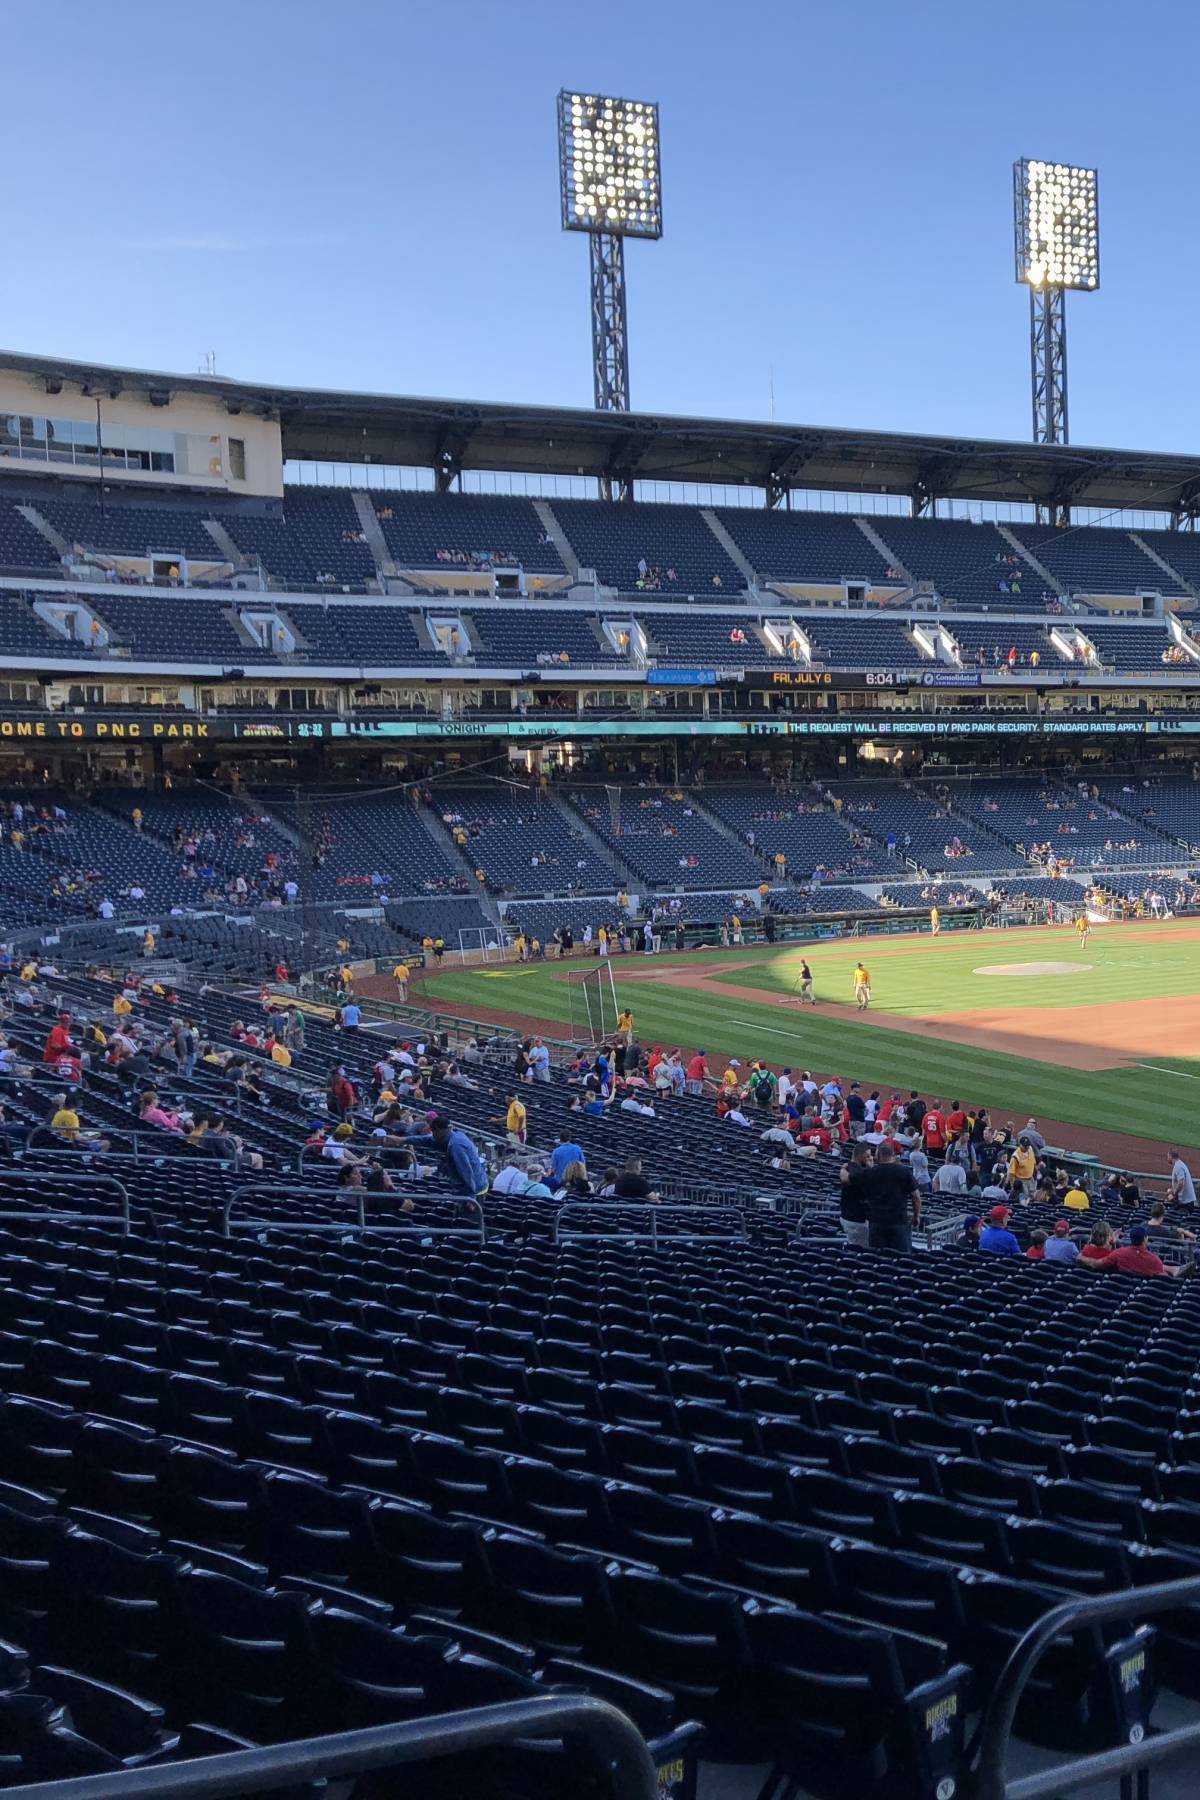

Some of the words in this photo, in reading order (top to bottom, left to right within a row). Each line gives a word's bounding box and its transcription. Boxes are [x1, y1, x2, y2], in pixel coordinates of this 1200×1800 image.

[773, 673, 792, 685] FRI,
[795, 672, 822, 684] JULY
[824, 673, 832, 684] 6
[866, 673, 894, 685] 6:04
[935, 673, 978, 682] Consolidated
[58, 723, 84, 736] TO
[97, 723, 140, 737] PNC
[153, 724, 208, 737] PARK
[438, 724, 487, 733] TONIGHT
[789, 723, 809, 732] THE
[810, 723, 853, 733] REQUEST
[855, 723, 877, 732] WILL
[879, 723, 891, 732] BE
[893, 723, 936, 732] RECEIVED
[937, 723, 949, 732] BY
[951, 723, 970, 732] PNC
[972, 723, 995, 732] PARK
[998, 723, 1040, 732] SECURITY.
[1043, 723, 1089, 732] STANDARD
[1090, 723, 1116, 732] RATES
[1117, 723, 1144, 732] APPLY.
